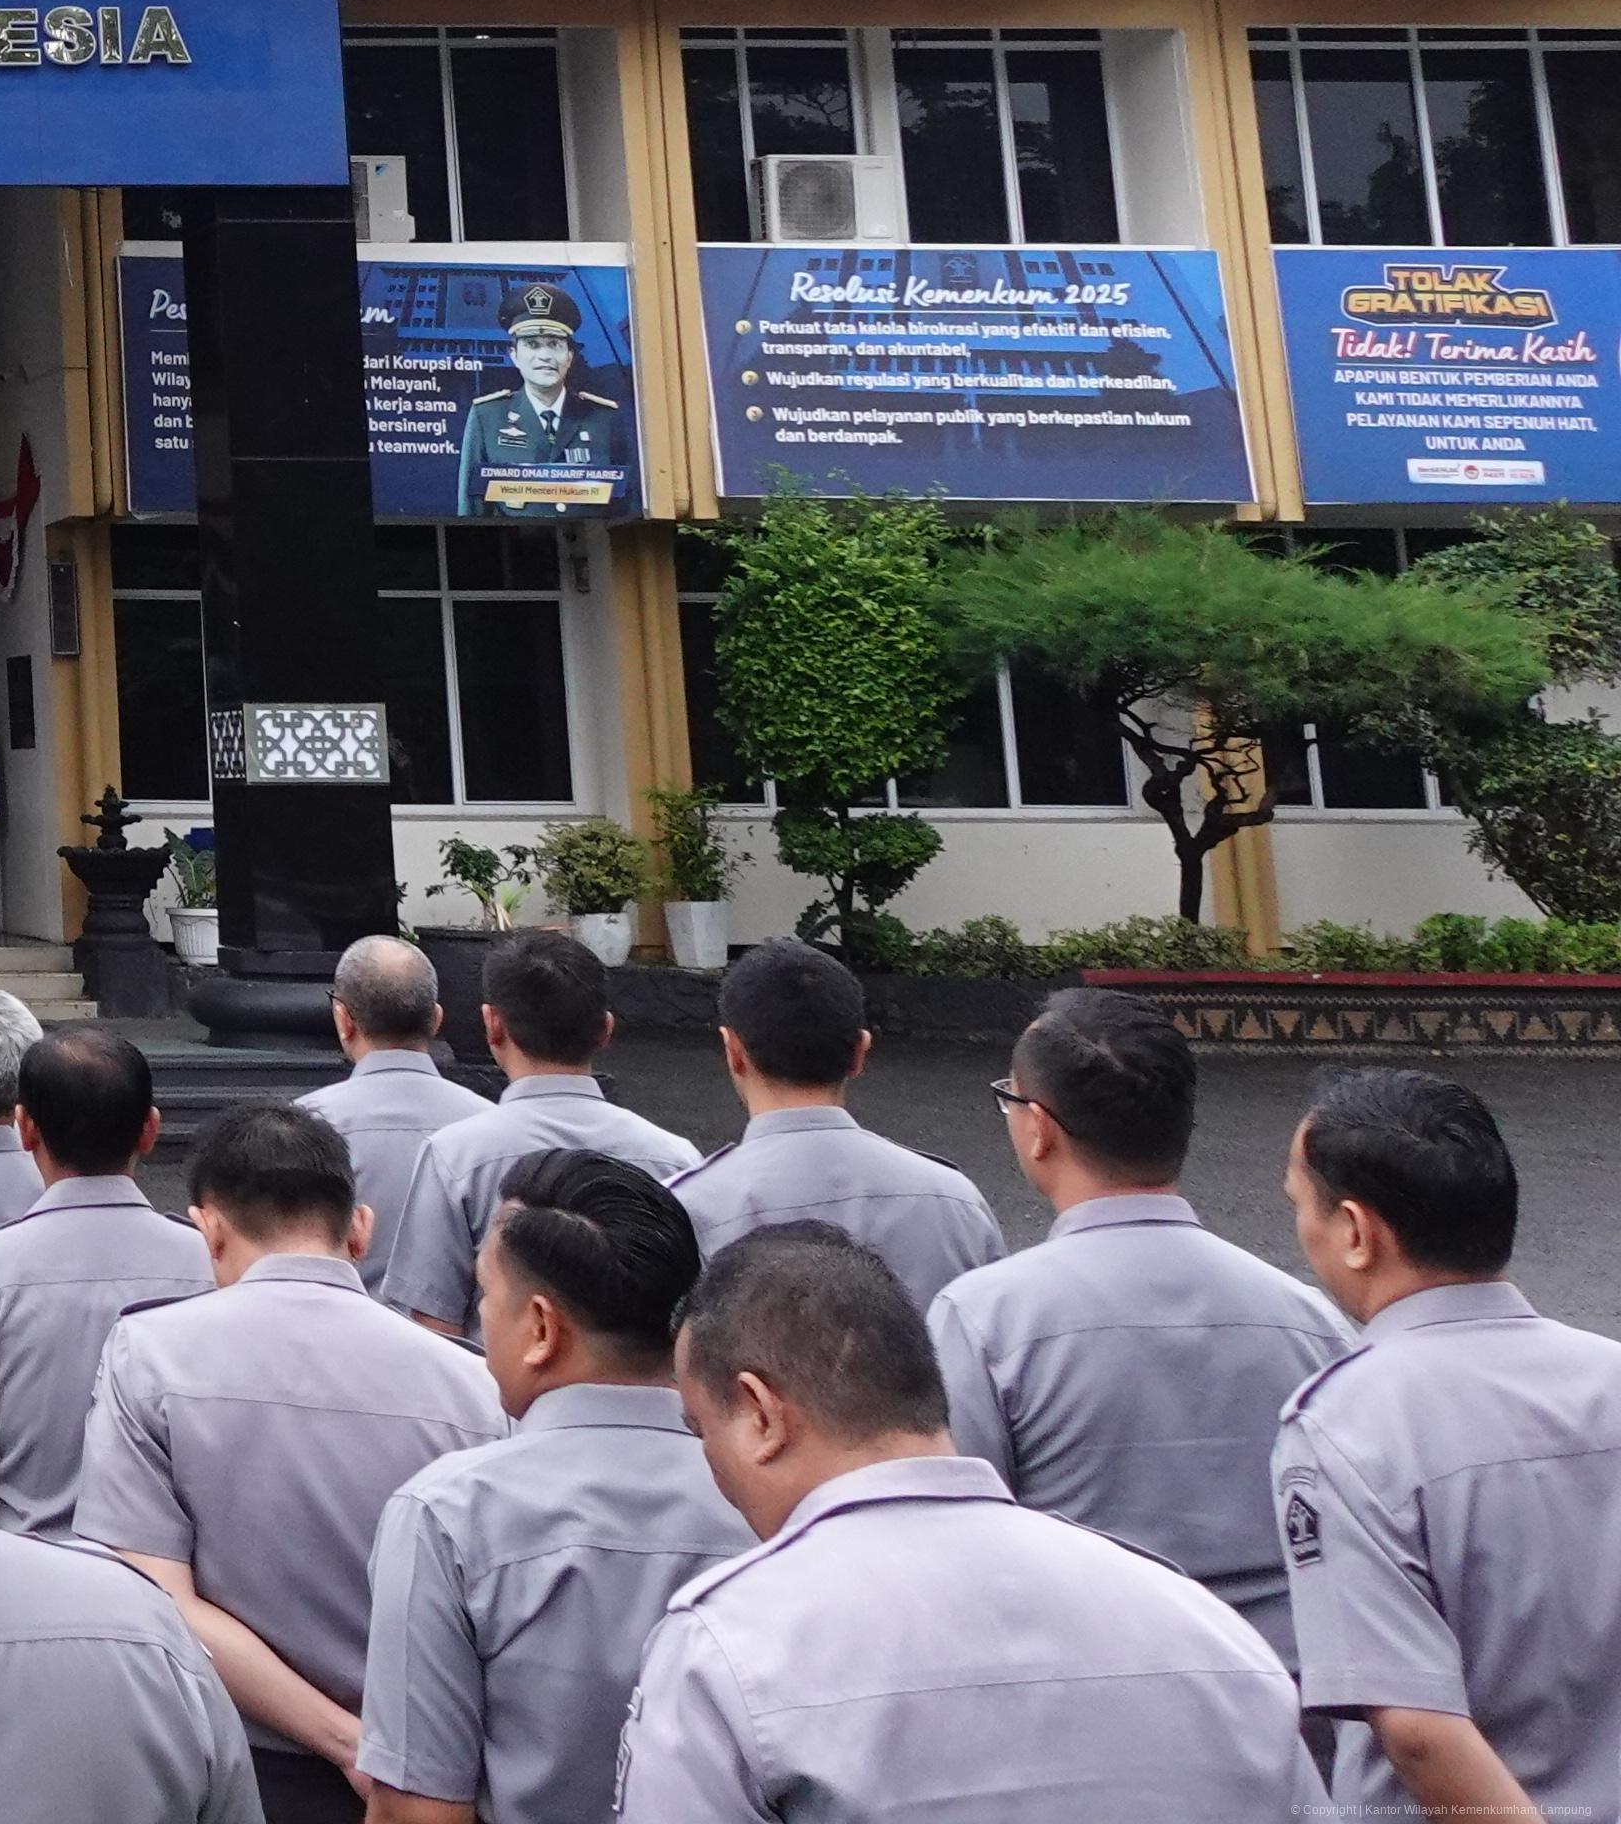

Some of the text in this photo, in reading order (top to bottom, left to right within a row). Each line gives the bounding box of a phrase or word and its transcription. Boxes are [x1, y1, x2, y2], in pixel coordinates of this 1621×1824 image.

[790, 272, 1131, 307] Resolusi Kemenkum 2025
[1391, 270, 1495, 292] TOLAK
[150, 289, 187, 320] Pes
[1347, 292, 1549, 317] GRATIFIKASI
[758, 320, 821, 334] Perkuat
[824, 322, 857, 335] tata
[859, 321, 906, 335] kelola
[908, 321, 979, 336] birokrasi
[981, 325, 1020, 339] yang
[1023, 324, 1077, 336] efektif
[1079, 324, 1108, 337] dan
[762, 342, 971, 357] transparan, dan akuntabel,
[1331, 327, 1596, 365] Tidak! Terima Kasih
[151, 351, 189, 365] Mem
[393, 356, 451, 373] Korupsi
[454, 357, 483, 371] dan
[152, 372, 441, 393] Wilay Melayani,
[766, 371, 1177, 391] Wujudkan regulasi yang berkualitas dan berkeadilan,
[1334, 370, 1599, 388] APAPUN BENTUK PEMBERIAN ANDA
[153, 393, 192, 410] hany
[374, 397, 412, 414] kerja
[415, 401, 457, 412] sama
[1355, 392, 1583, 409] KAMI TIDAK MEMERLUKANNYA
[154, 414, 182, 428] dan
[369, 418, 447, 436] bersinergi
[773, 407, 1191, 426] Wujudkan pelayanan publik yang berkepastian hukum
[1346, 413, 1440, 428] PELAYANAN
[1442, 414, 1481, 429] KAMI
[1483, 415, 1555, 430] SEPENUH
[155, 435, 189, 449] satu
[377, 440, 460, 454] teamwork.
[775, 429, 903, 446] dan berdampak.
[1425, 436, 1526, 451] UNTUK ANDA
[481, 467, 624, 480] EDWARD OMAR SHARIF HIARIEJ
